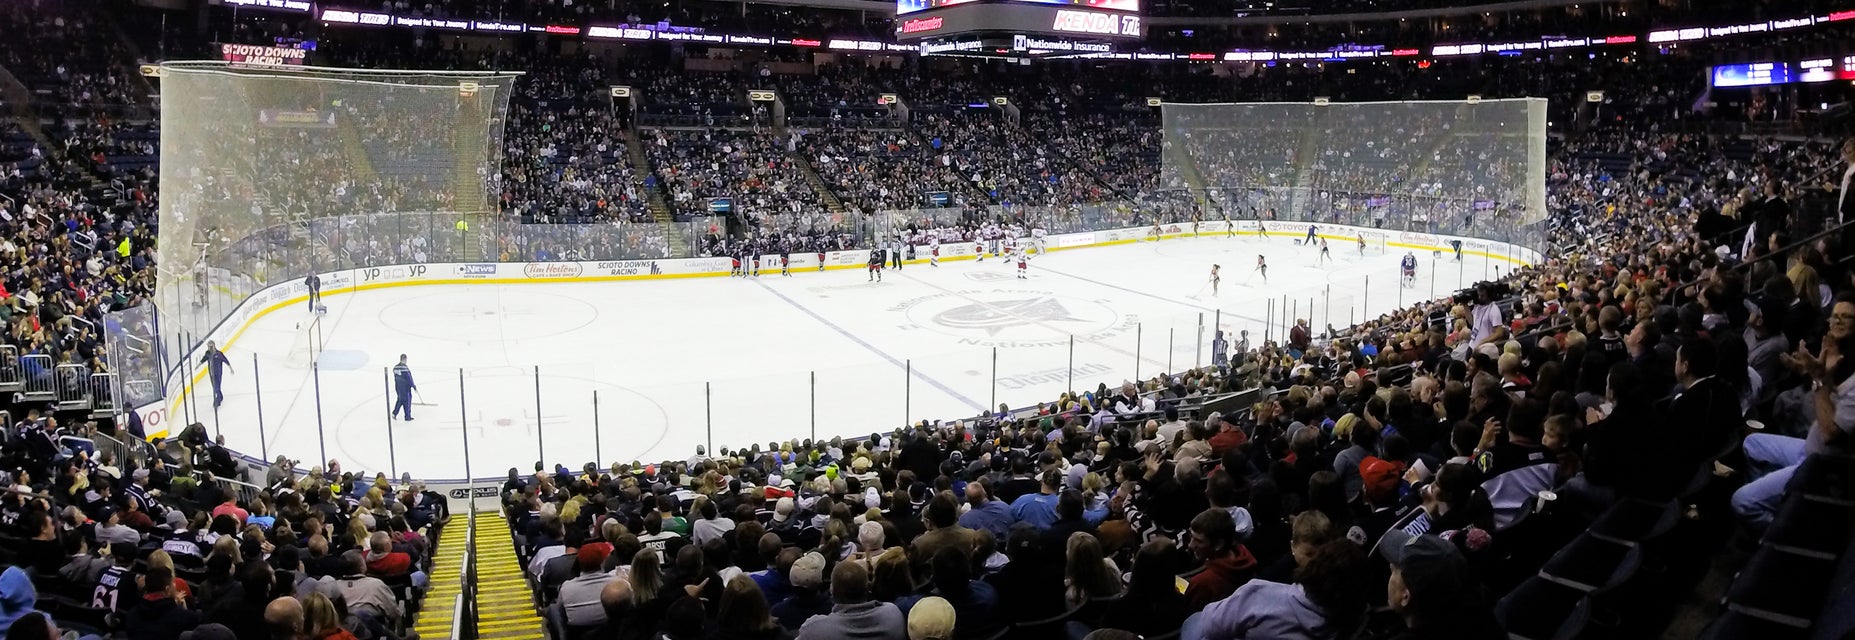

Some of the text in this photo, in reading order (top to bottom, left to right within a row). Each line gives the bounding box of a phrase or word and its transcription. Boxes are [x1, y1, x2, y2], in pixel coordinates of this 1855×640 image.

[360, 13, 390, 25] TIRES
[398, 17, 422, 27] Designed
[446, 21, 468, 29] Journey
[1053, 10, 1118, 34] KENDA
[624, 28, 651, 39] TIRES
[658, 32, 682, 40] Designed
[1027, 39, 1110, 51] Nationwide Insurance
[223, 44, 306, 59] SCIOTO DOWNS
[245, 55, 283, 65] RACINO
[1281, 223, 1312, 231] TOYOT
[409, 265, 427, 277] yp
[530, 262, 577, 273] Tim Hortons
[363, 268, 380, 281] yp
[463, 487, 497, 495] LXUS
[92, 585, 118, 613] 61
